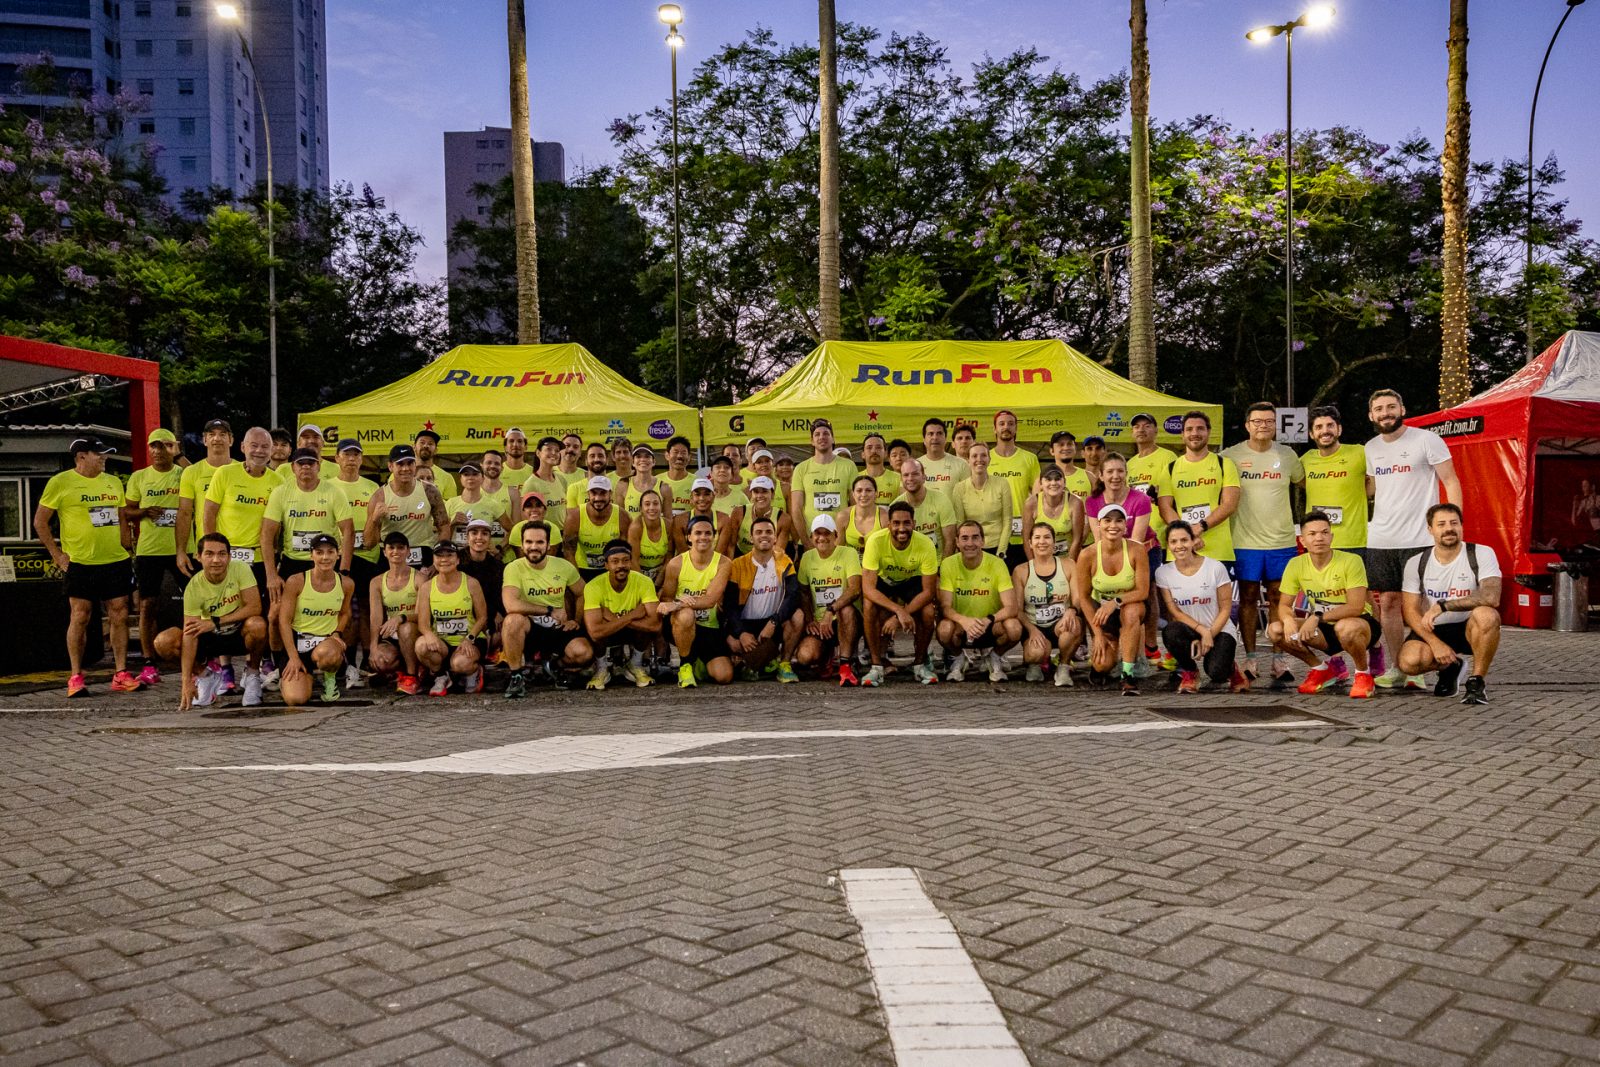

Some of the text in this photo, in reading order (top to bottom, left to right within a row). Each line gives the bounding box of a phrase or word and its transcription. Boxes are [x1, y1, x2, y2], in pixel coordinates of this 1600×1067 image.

[437, 369, 587, 388] RunFun
[851, 363, 1053, 386] RunFun
[853, 423, 893, 431] Heineken
[1026, 417, 1064, 428] tfsports
[1098, 420, 1129, 428] parmalat
[1281, 414, 1305, 436] F 2
[357, 429, 394, 442] MRM
[465, 428, 506, 440] RunFu
[545, 426, 585, 438] tfsports
[599, 427, 632, 436] parmalat
[1375, 463, 1411, 476] RunFun
[925, 474, 951, 482] unFun
[1128, 473, 1152, 484] RunFun
[1241, 471, 1282, 483] RunFun
[1307, 470, 1348, 481] RunFun
[813, 478, 841, 487] RunFun
[1176, 477, 1217, 489] RunFun
[81, 493, 119, 503] RunFun
[236, 494, 268, 506] RunFu
[817, 497, 838, 505] 1403
[99, 512, 111, 520] 97
[289, 509, 327, 519] RunFun
[389, 512, 425, 522] RunFun
[1187, 510, 1206, 520] 308
[811, 577, 843, 586] RunFun
[528, 587, 563, 597] RunFun
[823, 592, 835, 600] 60
[955, 586, 990, 596] RunFun
[1307, 588, 1347, 599] RunFun
[1427, 588, 1471, 599] RunFun
[433, 607, 471, 617] RunFun
[1040, 608, 1062, 617] 1378
[441, 621, 464, 630] 1070
